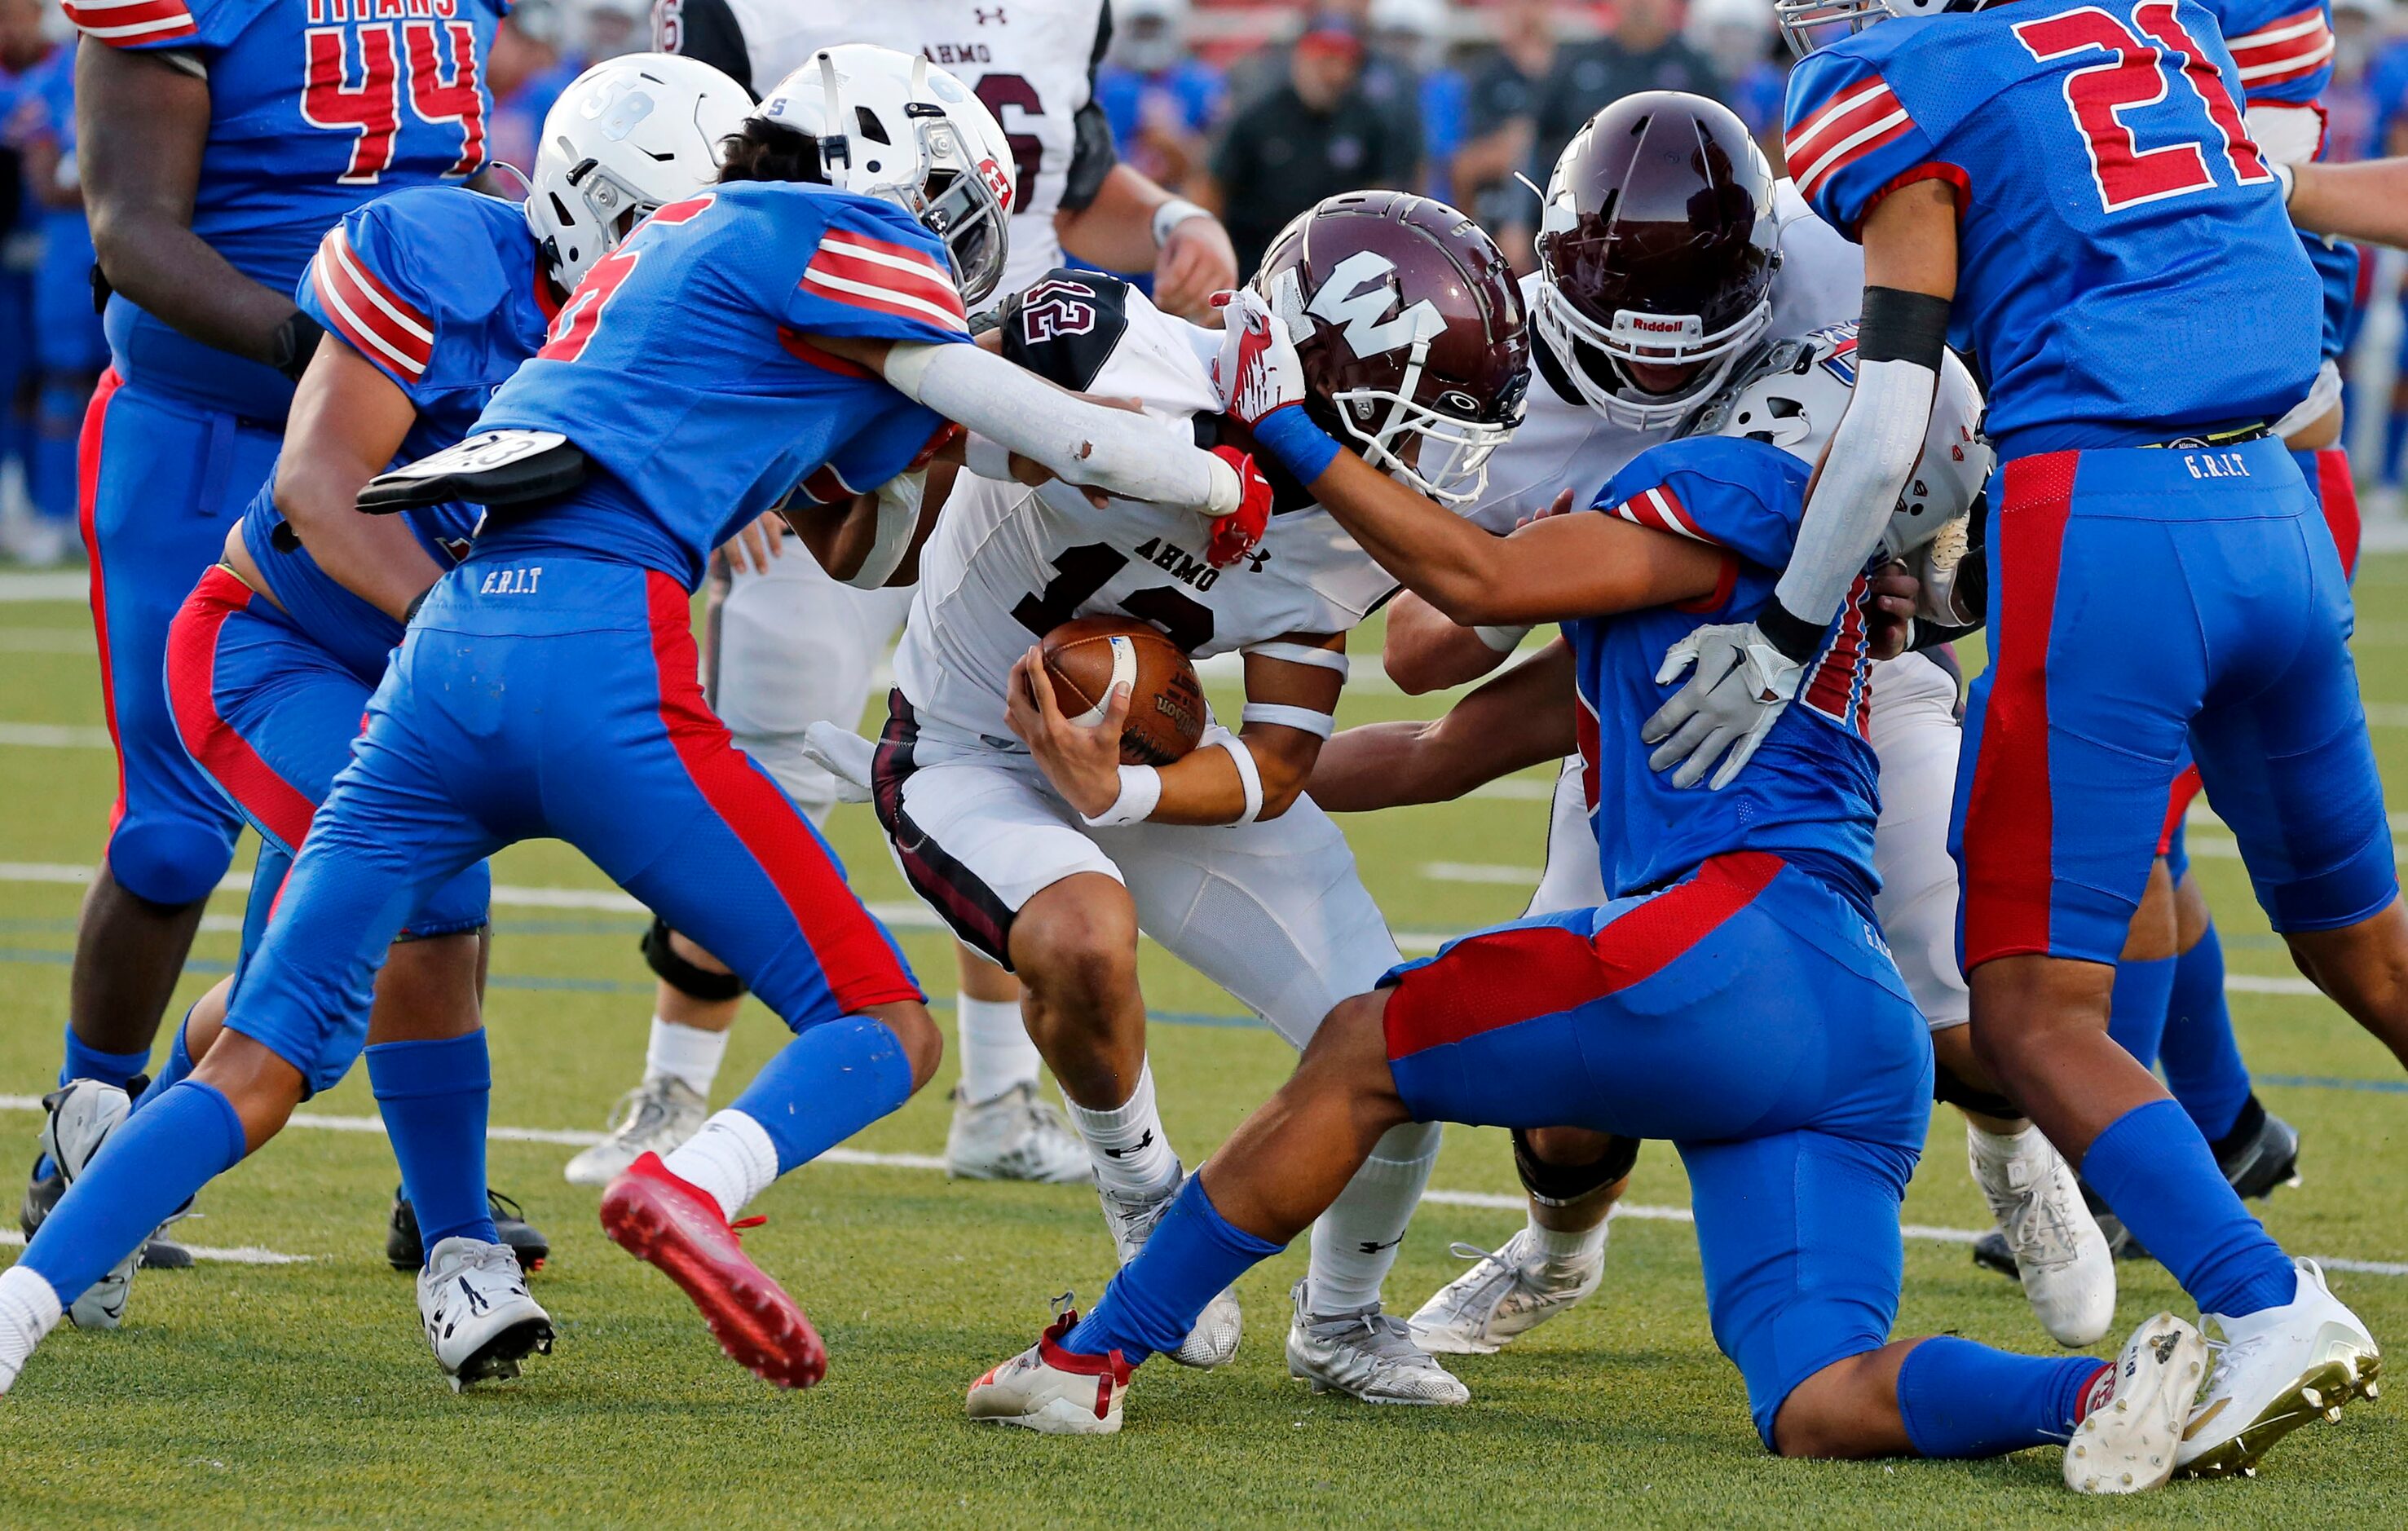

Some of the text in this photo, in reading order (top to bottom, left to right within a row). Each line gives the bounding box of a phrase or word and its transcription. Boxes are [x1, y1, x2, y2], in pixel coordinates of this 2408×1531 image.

[300, 20, 486, 184] 44
[2010, 0, 2274, 214] 21
[1021, 280, 1096, 346] 12
[1306, 250, 1449, 360] W
[1633, 317, 1683, 333] Riddell
[2184, 452, 2250, 479] G.R.I.T
[480, 567, 542, 594] G.R.I.T
[1134, 536, 1220, 592] AHMO
